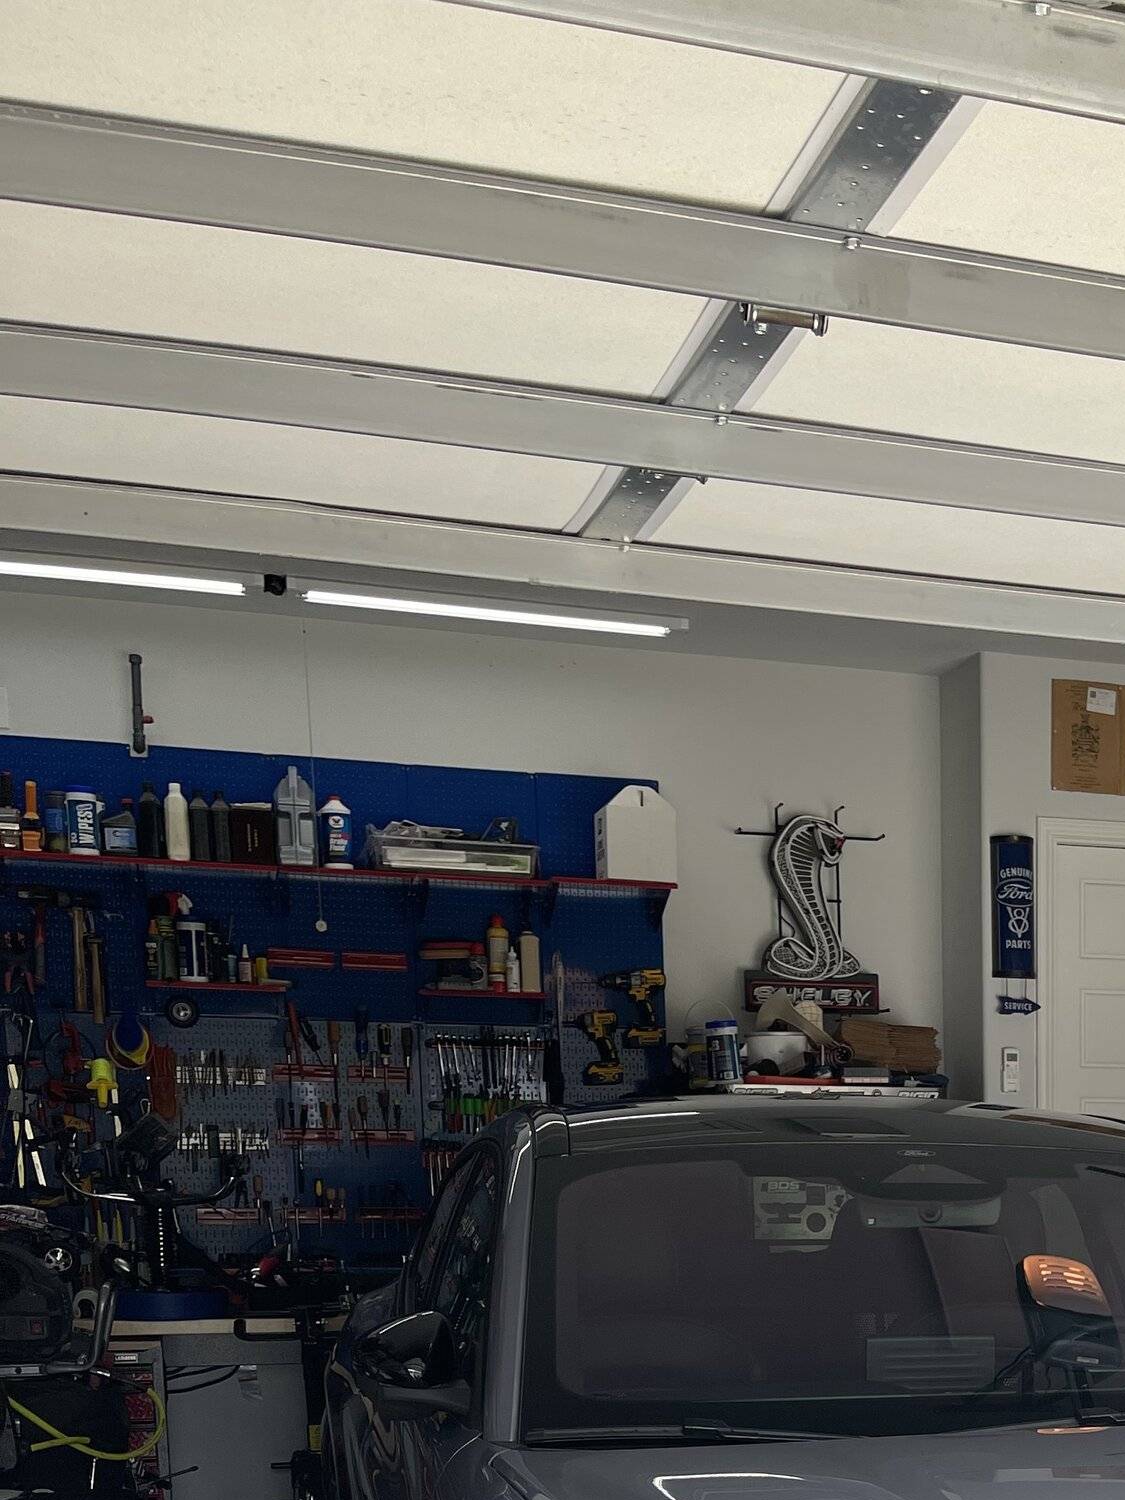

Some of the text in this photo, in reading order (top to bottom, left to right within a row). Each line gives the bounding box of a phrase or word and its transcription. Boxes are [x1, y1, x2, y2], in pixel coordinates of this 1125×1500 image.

[997, 883, 1033, 900] Ford
[1005, 939, 1032, 950] PARTS
[1004, 1002, 1033, 1011] SERVICE
